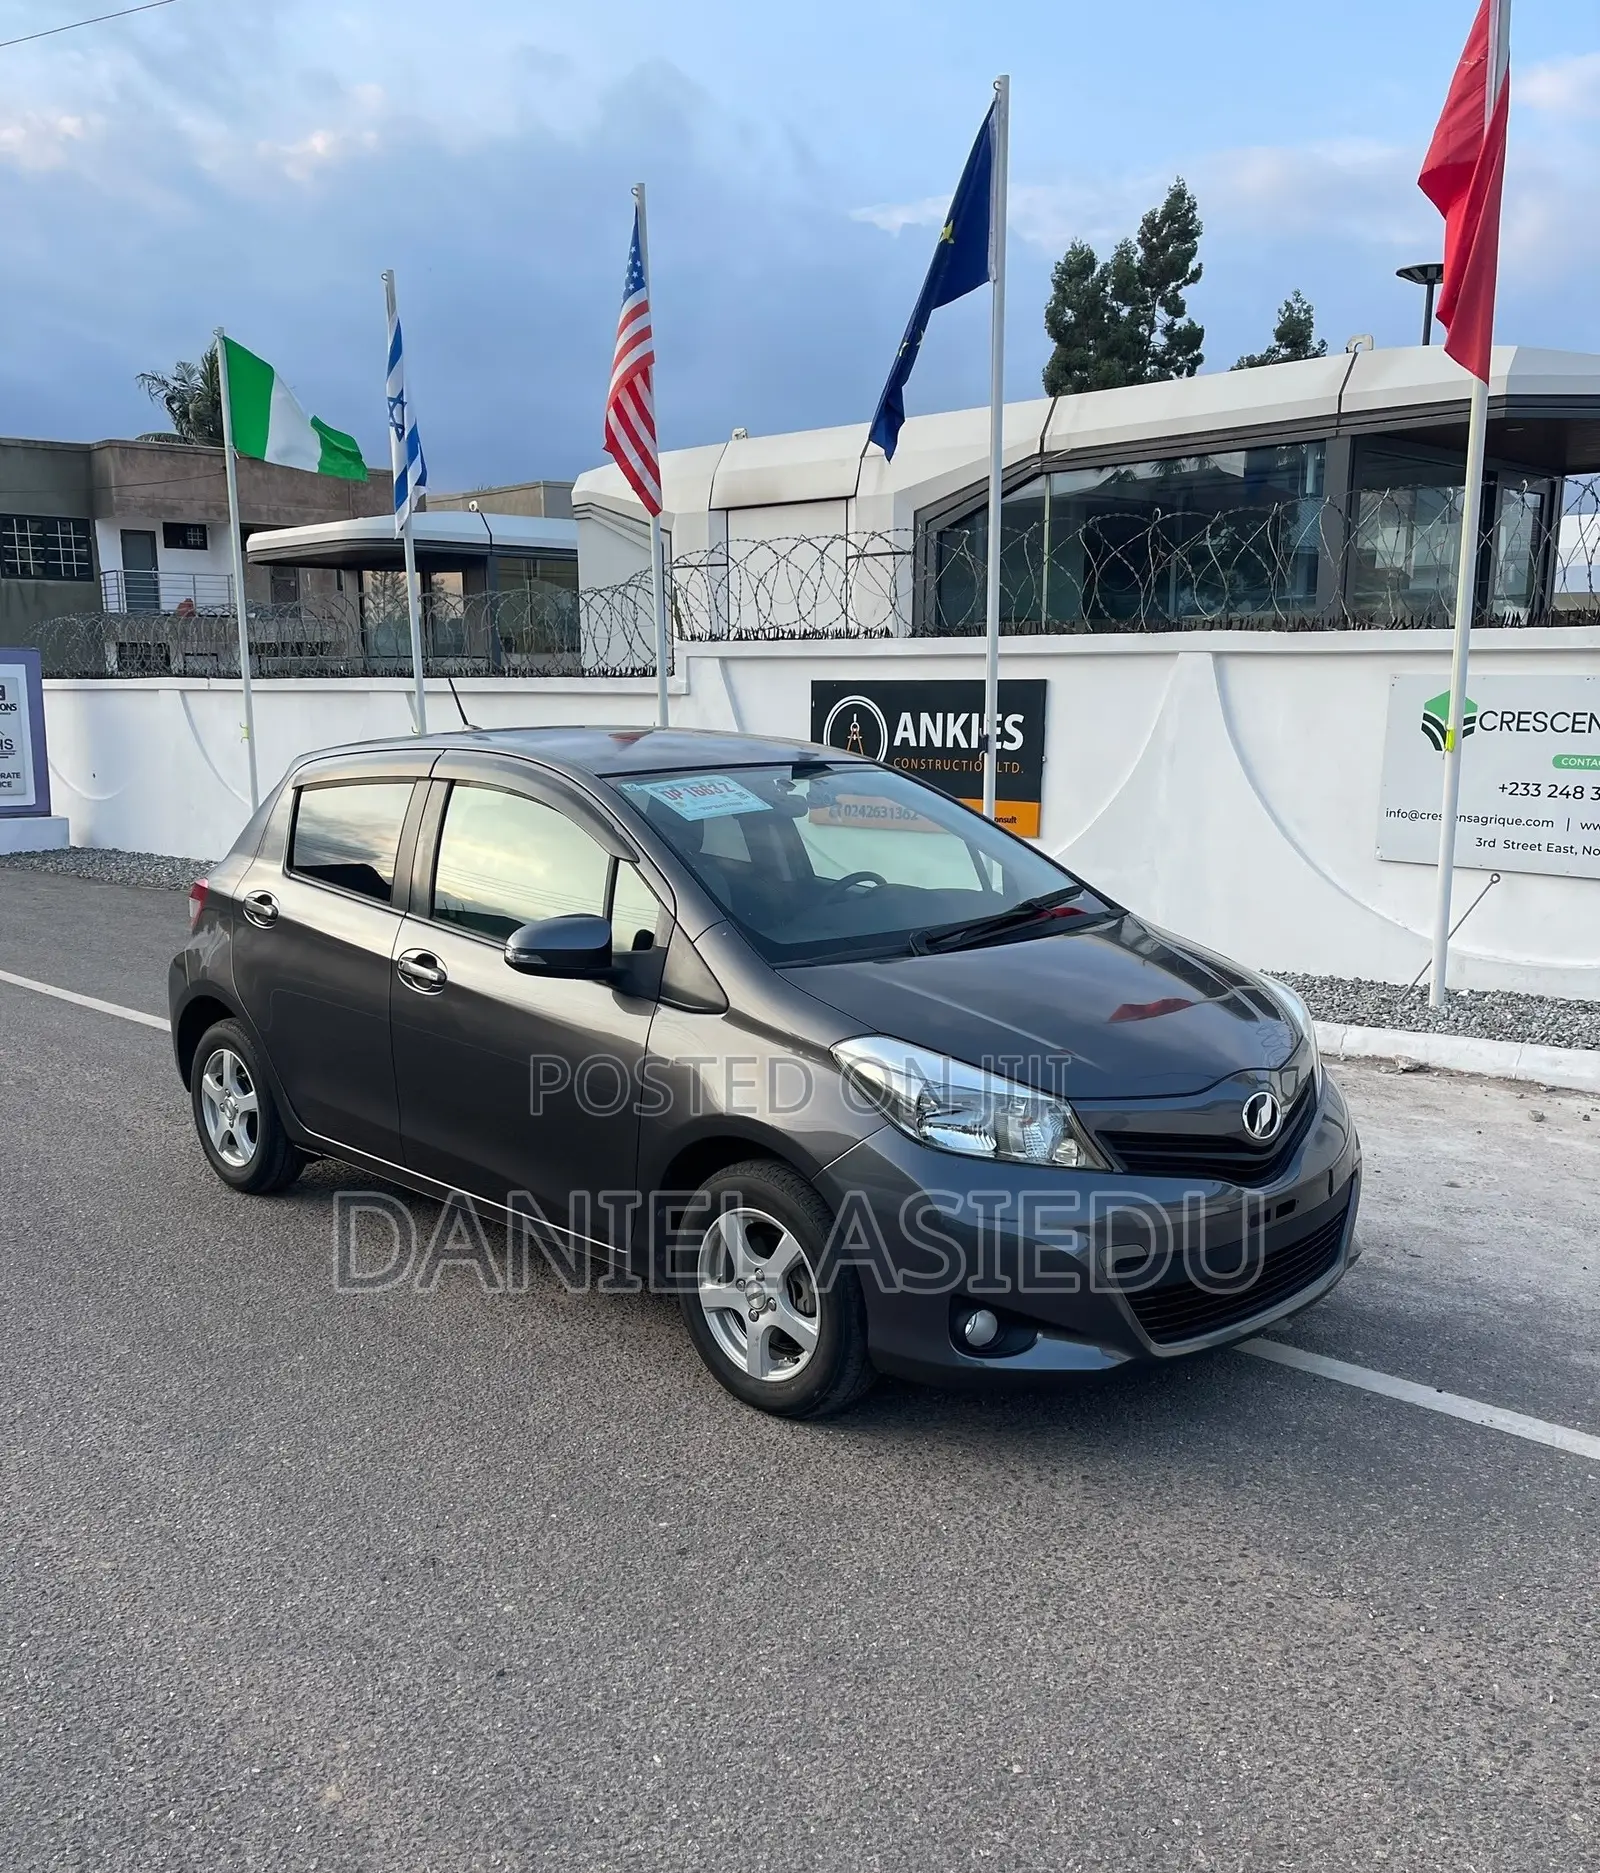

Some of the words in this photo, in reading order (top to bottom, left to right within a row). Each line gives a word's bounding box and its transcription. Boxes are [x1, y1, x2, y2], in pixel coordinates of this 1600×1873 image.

[893, 757, 983, 772] CONSTRUCTIO
[996, 761, 1024, 774] LTD.
[1561, 757, 1600, 768] CONTA
[1498, 781, 1541, 798] +233
[1547, 783, 1585, 800] 248
[994, 815, 1017, 824] onsult
[1385, 807, 1554, 828] info@cresnsagrique.com
[1475, 837, 1497, 849] 3rd
[1503, 839, 1542, 852] Street
[1546, 842, 1578, 856] East,
